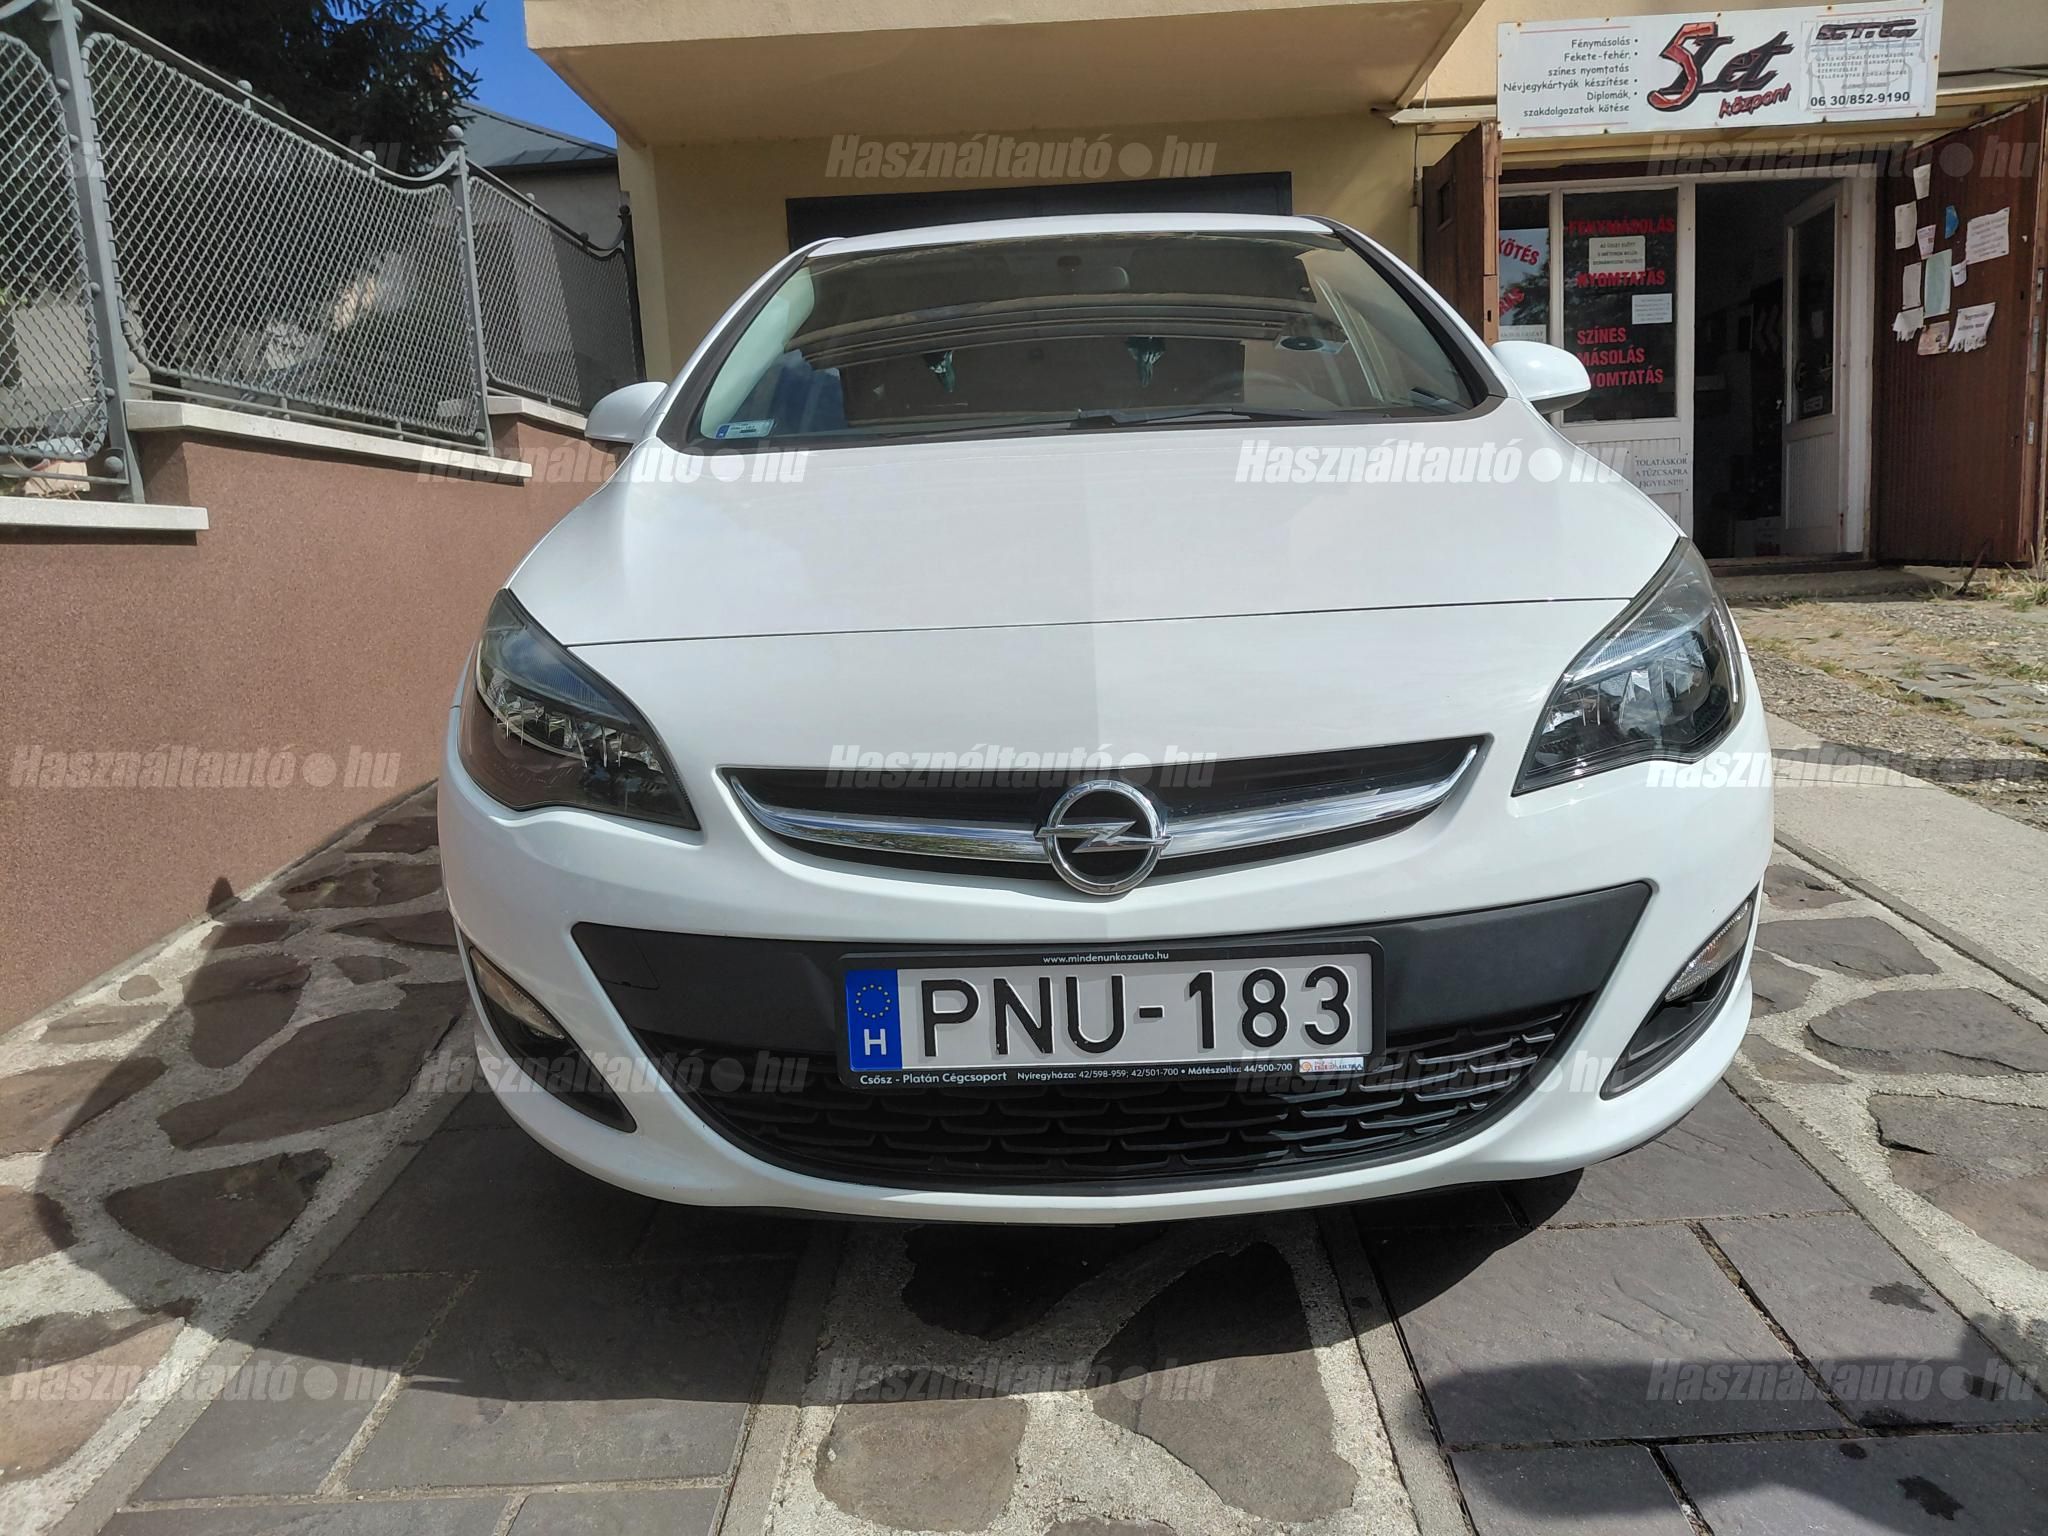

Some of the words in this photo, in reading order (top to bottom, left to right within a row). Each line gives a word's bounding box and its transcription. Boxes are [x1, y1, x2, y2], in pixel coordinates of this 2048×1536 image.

[1571, 36, 1630, 49] Fénymásolás
[1548, 66, 1577, 76] színes
[1580, 63, 1630, 76] nyomtatás
[1503, 80, 1579, 93] Névjegykártyák
[1585, 78, 1629, 88] készítése
[1719, 82, 1792, 119] központ
[1810, 96, 1826, 106] 06
[1830, 91, 1910, 106] 30/852-9190
[1524, 104, 1594, 117] szakdolgozatok
[1577, 326, 1626, 345] SZÍNES
[1043, 951, 1169, 964] www.mindenunkazauto.hu
[922, 965, 1351, 1057] PNU-183
[863, 1029, 887, 1056] H
[1131, 1067, 1178, 1077] 42/501-700
[1244, 1063, 1292, 1073] 44/500-700
[860, 1074, 892, 1086] Csősz
[903, 1073, 939, 1084] Platán
[942, 1072, 1007, 1085] Cégcsoport
